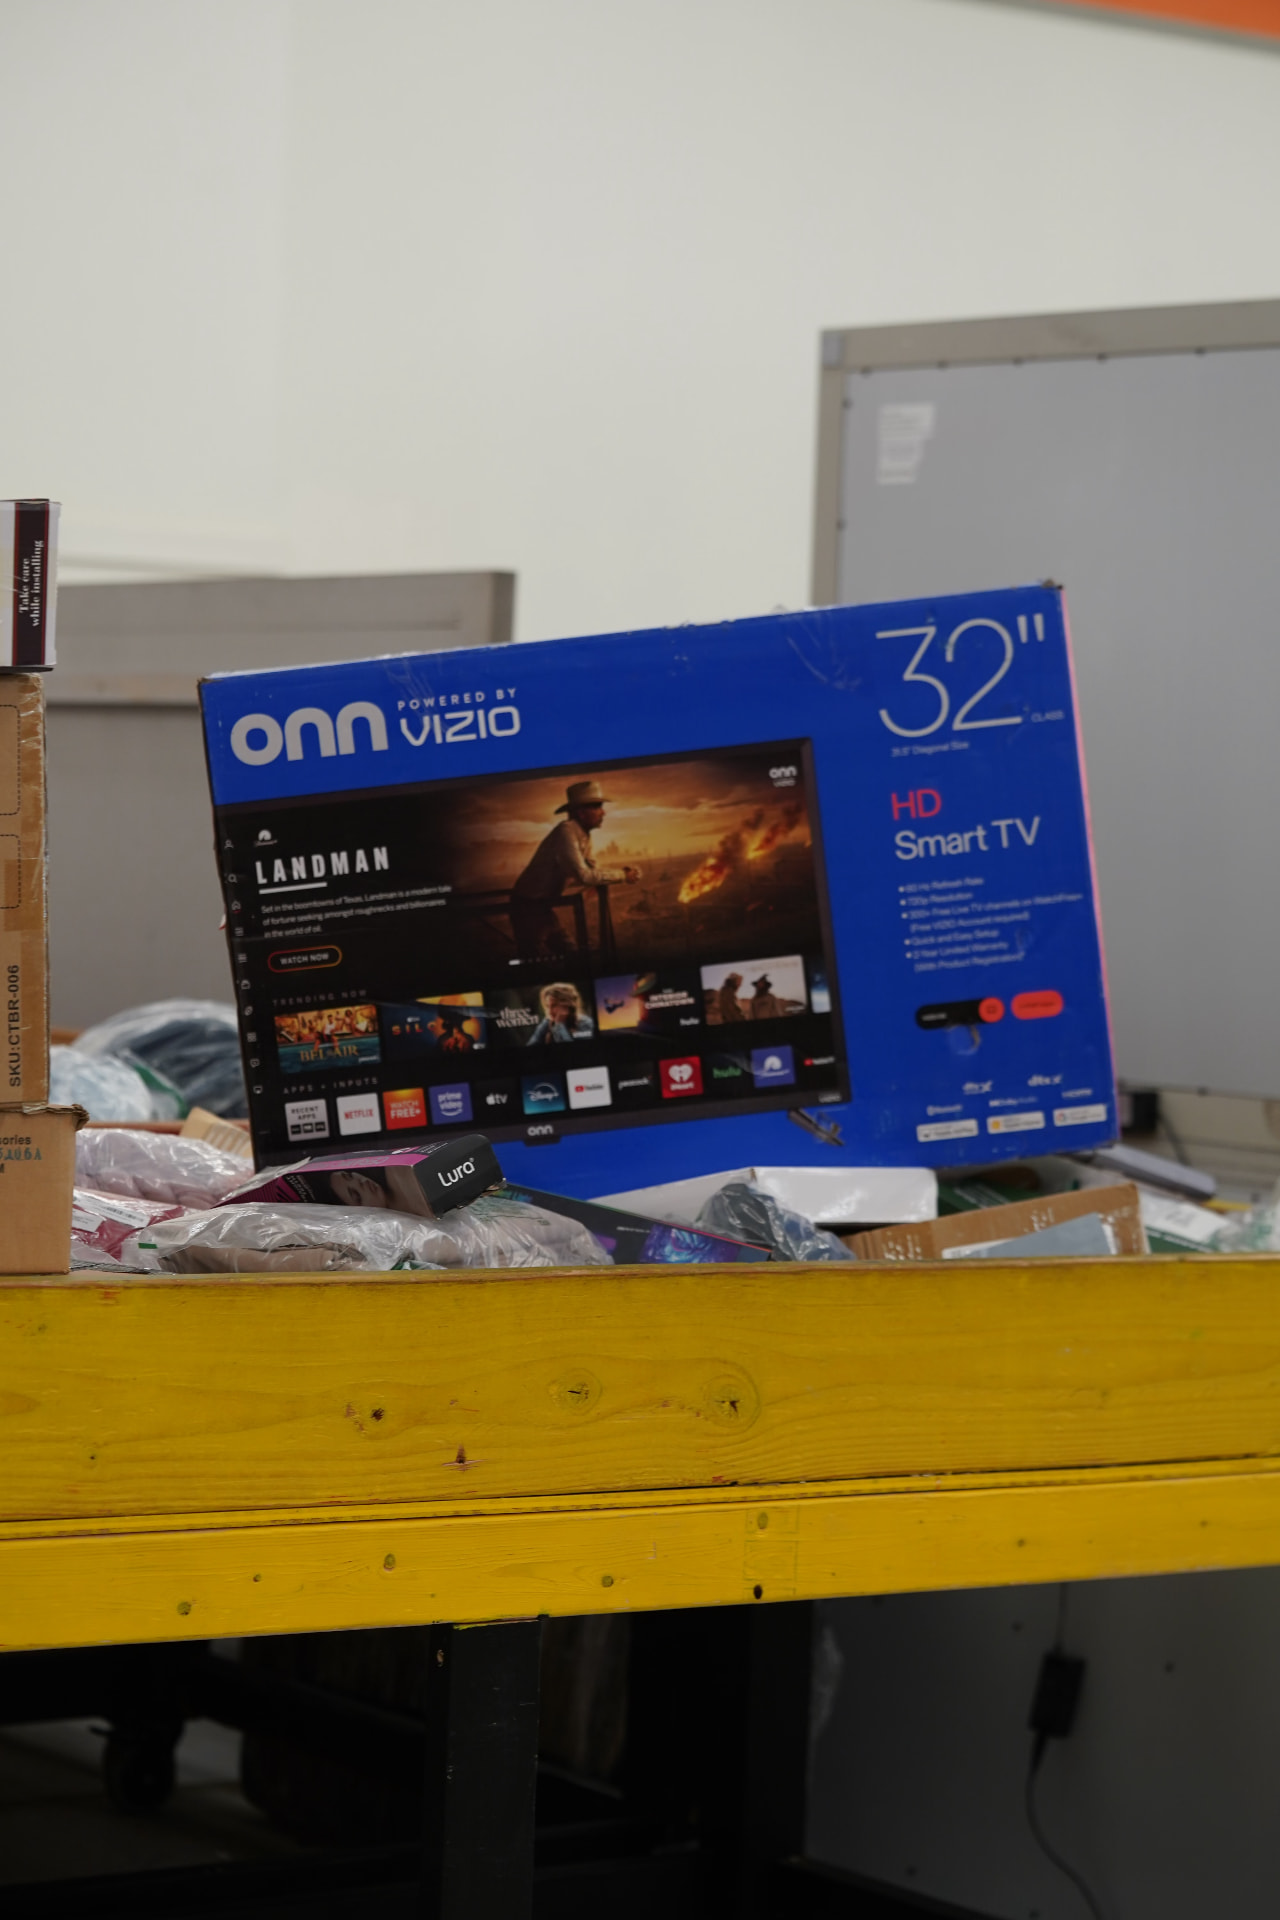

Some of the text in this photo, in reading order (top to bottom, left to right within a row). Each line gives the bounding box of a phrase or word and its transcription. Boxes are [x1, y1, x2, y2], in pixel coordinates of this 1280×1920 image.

[18, 558, 30, 613] Take care
[30, 540, 44, 627] while installing
[875, 612, 1045, 738] 32"
[397, 687, 517, 711] POWERED BY
[230, 701, 389, 766] onn
[400, 705, 521, 747] VIZIO
[769, 766, 798, 779] onn
[890, 788, 943, 821] HD
[894, 814, 1042, 861] Smart TV
[255, 846, 390, 885] LANDMAN
[280, 952, 330, 965] WATCH NOW
[272, 988, 367, 1007] TRENDING NOW
[500, 1006, 532, 1020] three
[7, 964, 21, 1088] SKU:CTBR-006
[712, 1065, 743, 1079] hulu
[283, 1084, 313, 1095] APPS
[333, 1077, 378, 1089] INPUTS
[389, 1100, 420, 1110] WATCH
[437, 1091, 463, 1103] prime
[439, 1100, 464, 1111] video
[291, 1105, 319, 1115] RECENT
[298, 1113, 317, 1121] APPS
[344, 1108, 374, 1121] NETFLIX
[0, 1133, 32, 1145] ories
[526, 1123, 553, 1138] onn
[437, 1160, 475, 1187] Lura
